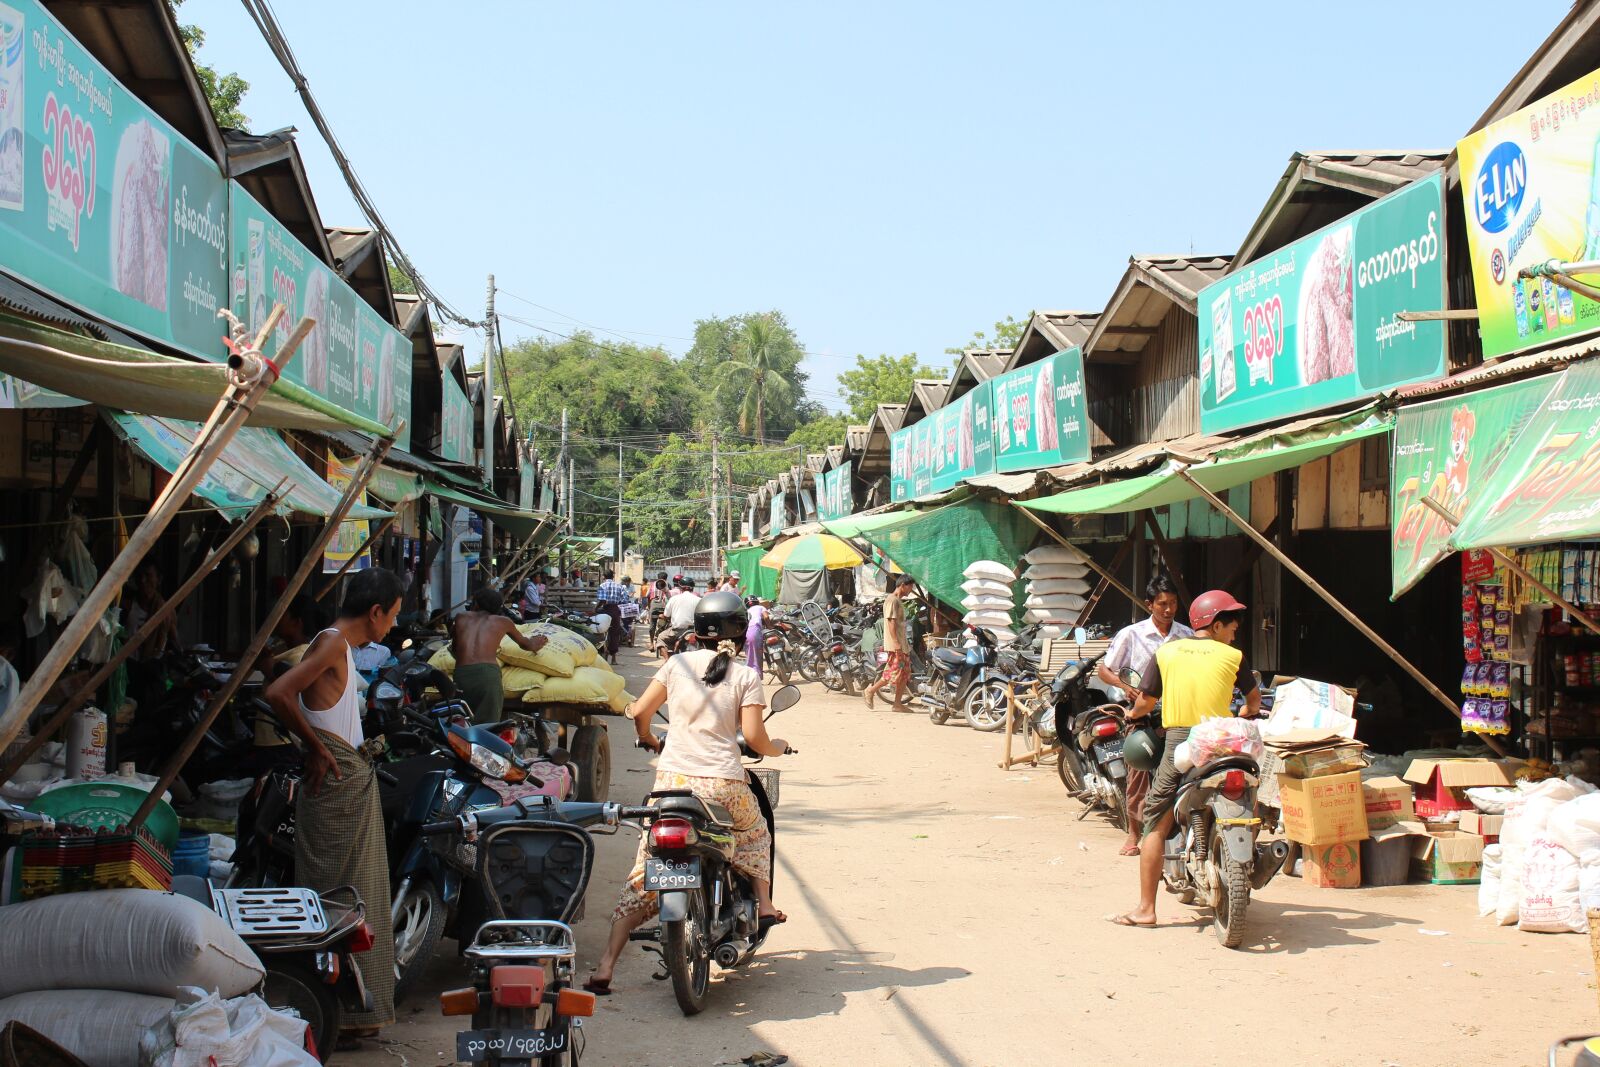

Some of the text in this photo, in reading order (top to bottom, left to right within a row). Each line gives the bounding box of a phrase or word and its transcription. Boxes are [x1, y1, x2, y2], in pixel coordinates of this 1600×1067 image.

[1476, 152, 1525, 225] E-LAN
[1358, 211, 1438, 288] လောကနတ်
